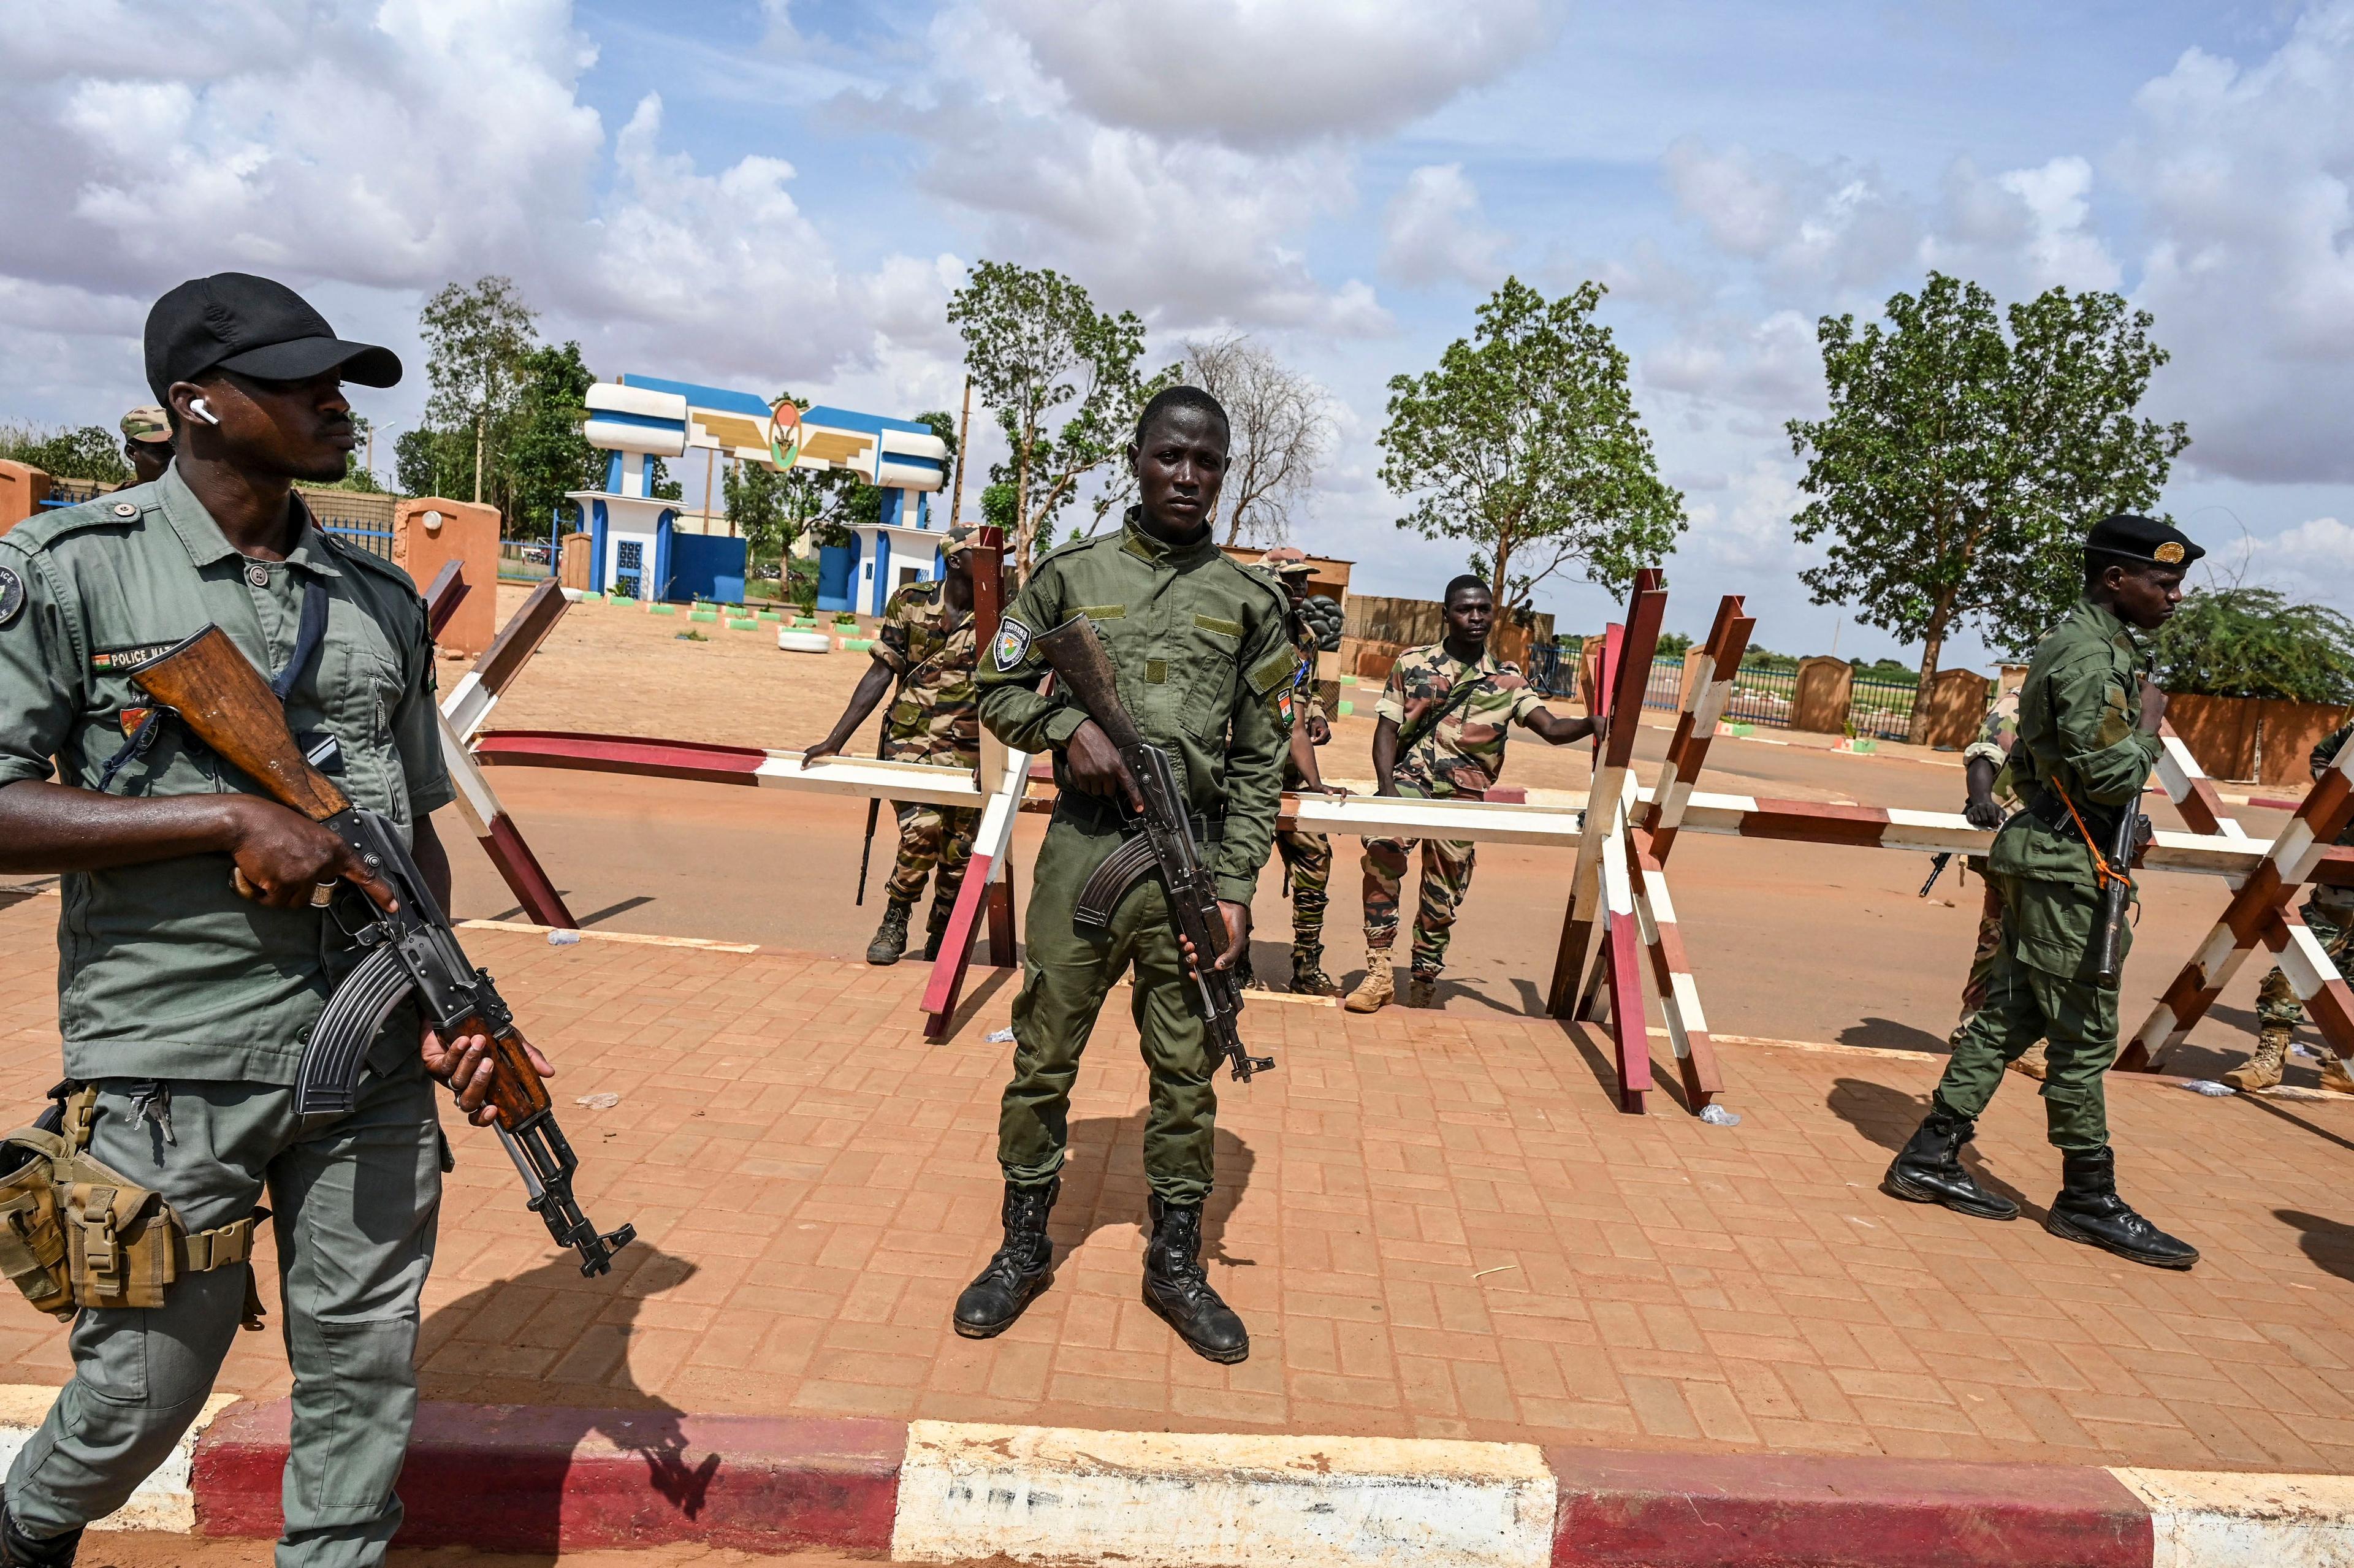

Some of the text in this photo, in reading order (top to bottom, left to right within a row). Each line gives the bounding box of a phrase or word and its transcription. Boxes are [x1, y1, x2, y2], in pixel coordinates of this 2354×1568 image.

[0, 571, 14, 584] ICE
[1005, 622, 1027, 637] POLICE
[1005, 628, 1024, 641] NATIONALE
[111, 650, 147, 667] POLICE
